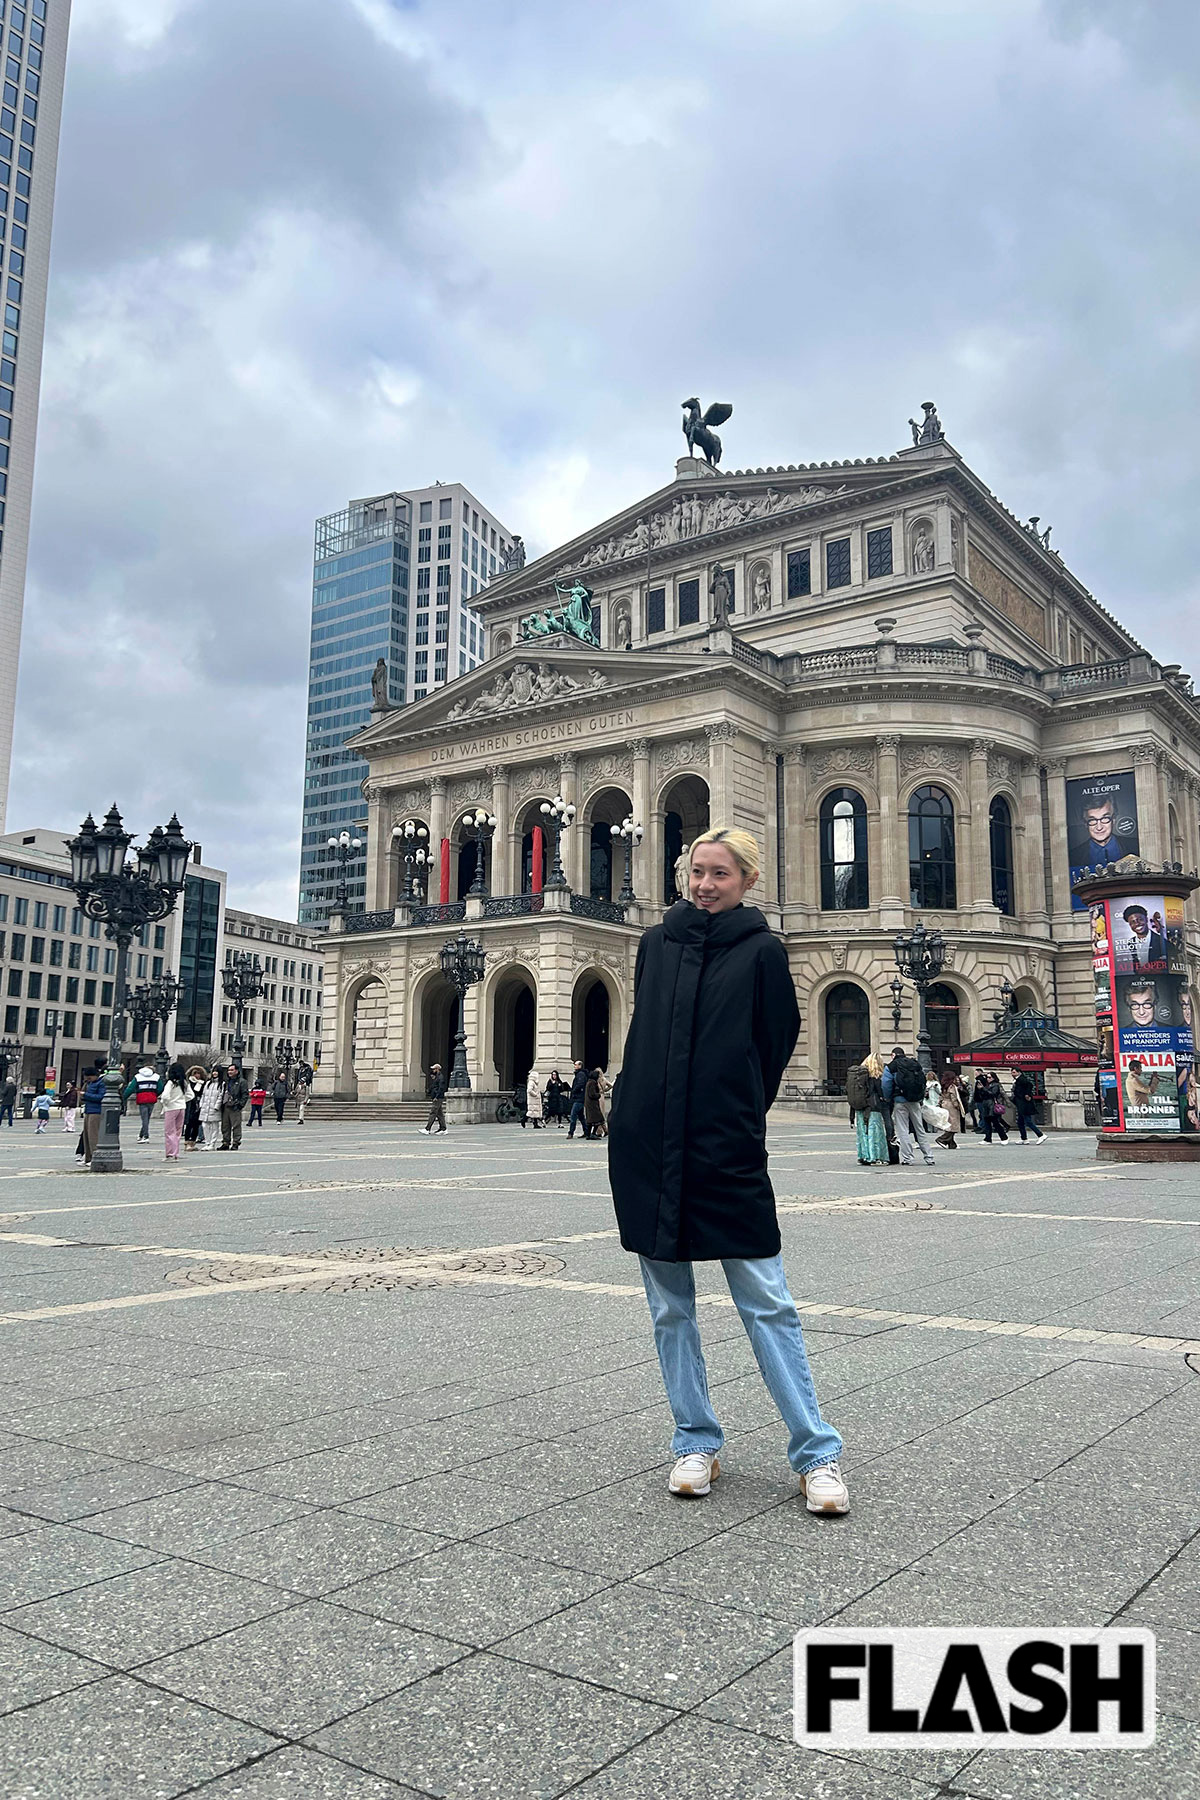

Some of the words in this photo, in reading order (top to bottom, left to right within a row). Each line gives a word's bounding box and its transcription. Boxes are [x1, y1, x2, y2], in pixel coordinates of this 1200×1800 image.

[431, 749, 455, 762] DEM
[459, 737, 509, 756] WAHREN
[515, 721, 582, 745] SCHOENEN
[589, 710, 638, 731] GUTEN.
[1082, 786, 1100, 795] ALTE
[1101, 784, 1120, 792] OPER
[1118, 962, 1141, 971] ALTE
[1143, 961, 1167, 970] OPER
[1122, 1053, 1175, 1067] ITALIA
[1152, 1096, 1172, 1104] TILL
[1127, 1103, 1176, 1114] BRÖNNER
